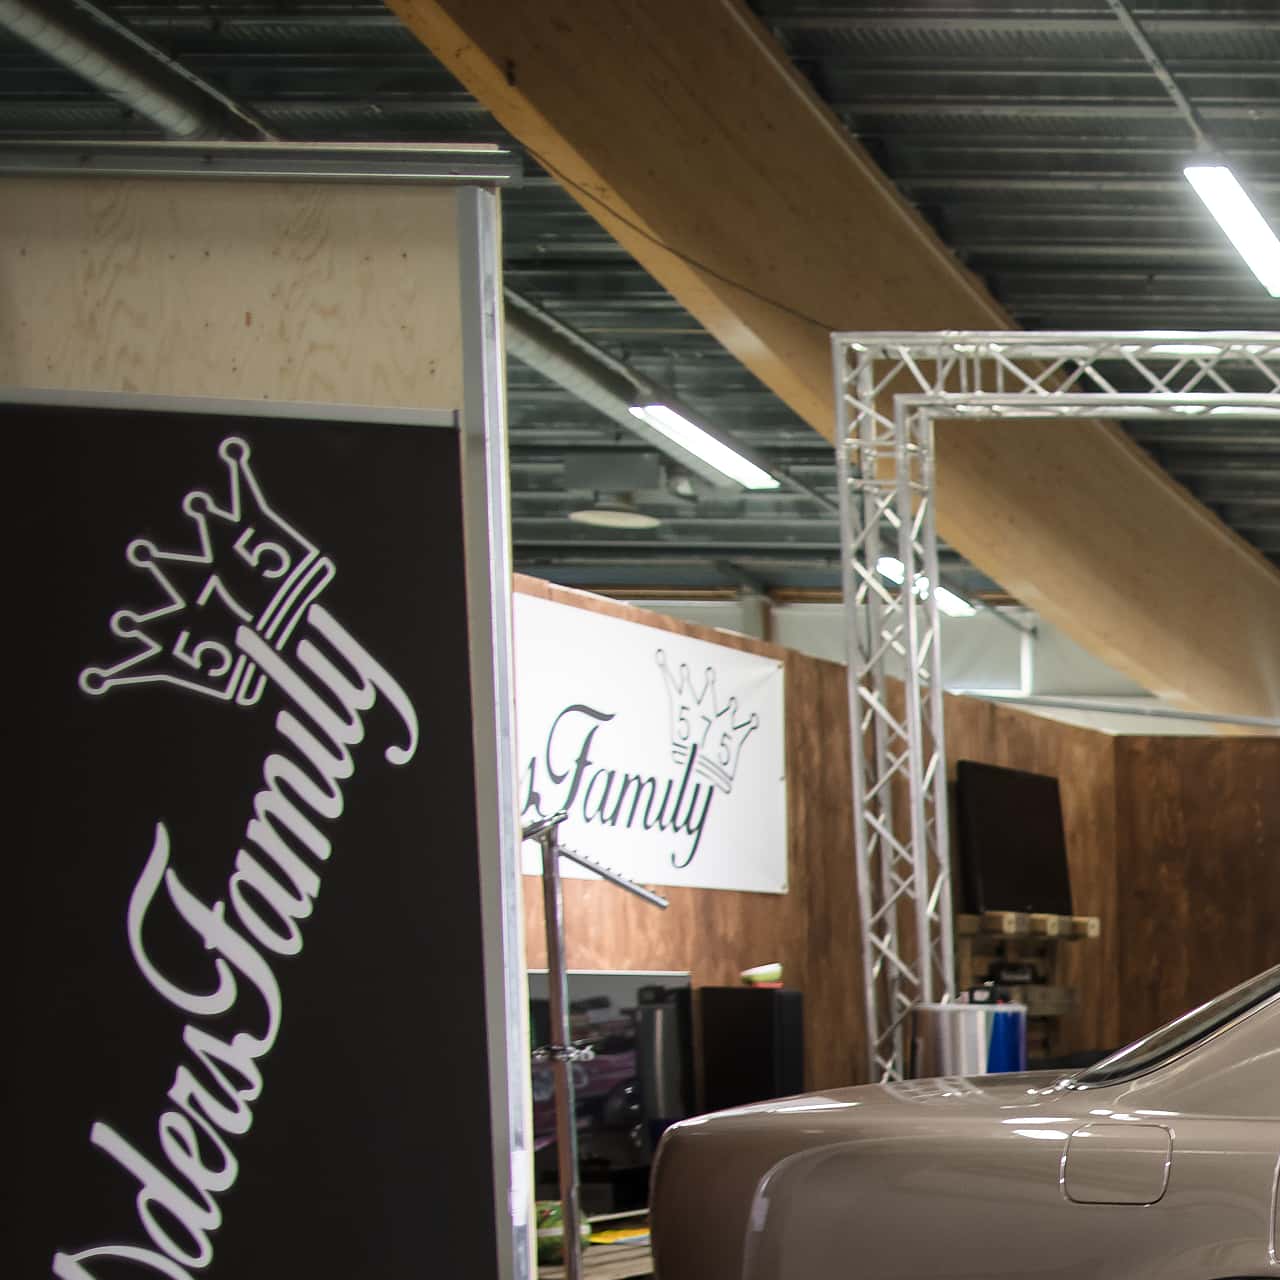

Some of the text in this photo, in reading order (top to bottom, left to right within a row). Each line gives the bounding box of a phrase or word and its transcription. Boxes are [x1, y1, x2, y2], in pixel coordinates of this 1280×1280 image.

[172, 527, 291, 678] 575
[127, 603, 419, 1056] Family
[546, 703, 716, 869] Family
